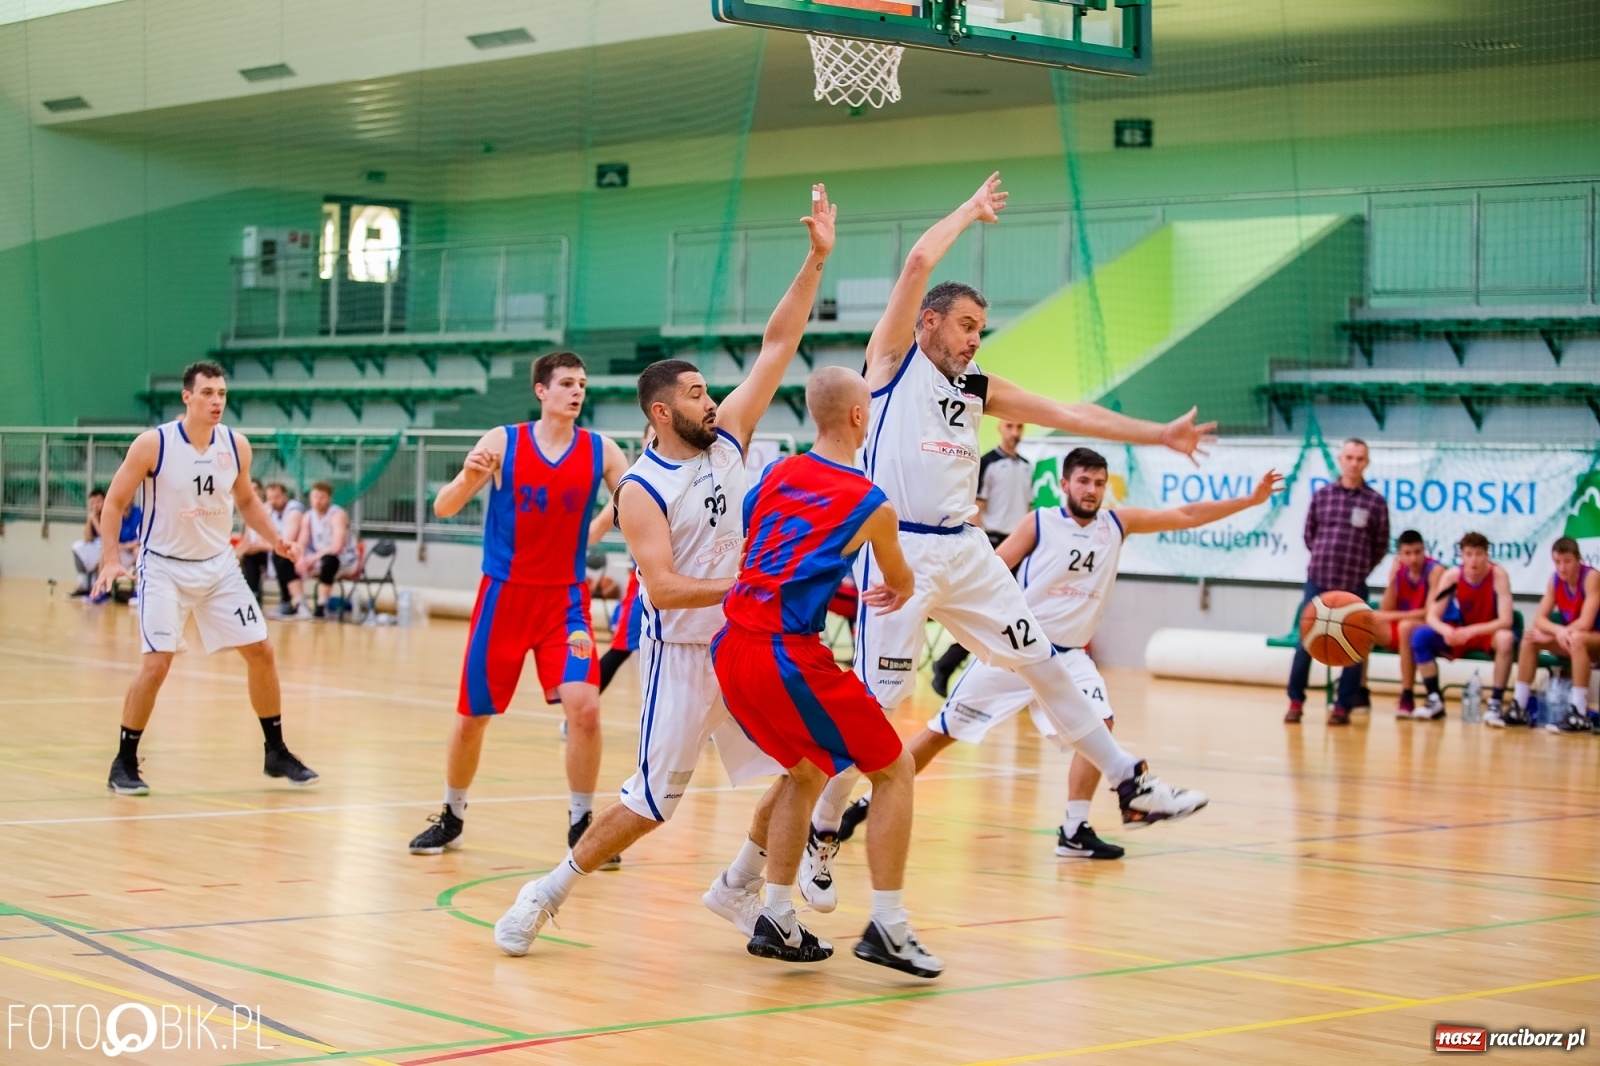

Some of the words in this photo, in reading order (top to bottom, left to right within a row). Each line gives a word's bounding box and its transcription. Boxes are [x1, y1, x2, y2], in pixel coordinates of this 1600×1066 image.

[953, 374, 967, 389] C
[938, 397, 966, 428] 12
[192, 474, 216, 496] 14
[519, 484, 548, 513] 24
[1161, 473, 1291, 507] POWI
[1310, 476, 1537, 515] IBORSKI
[704, 484, 728, 528] 35
[745, 511, 814, 576] 13
[1068, 548, 1096, 572] 24
[233, 603, 258, 627] 14
[1001, 618, 1038, 650] 12
